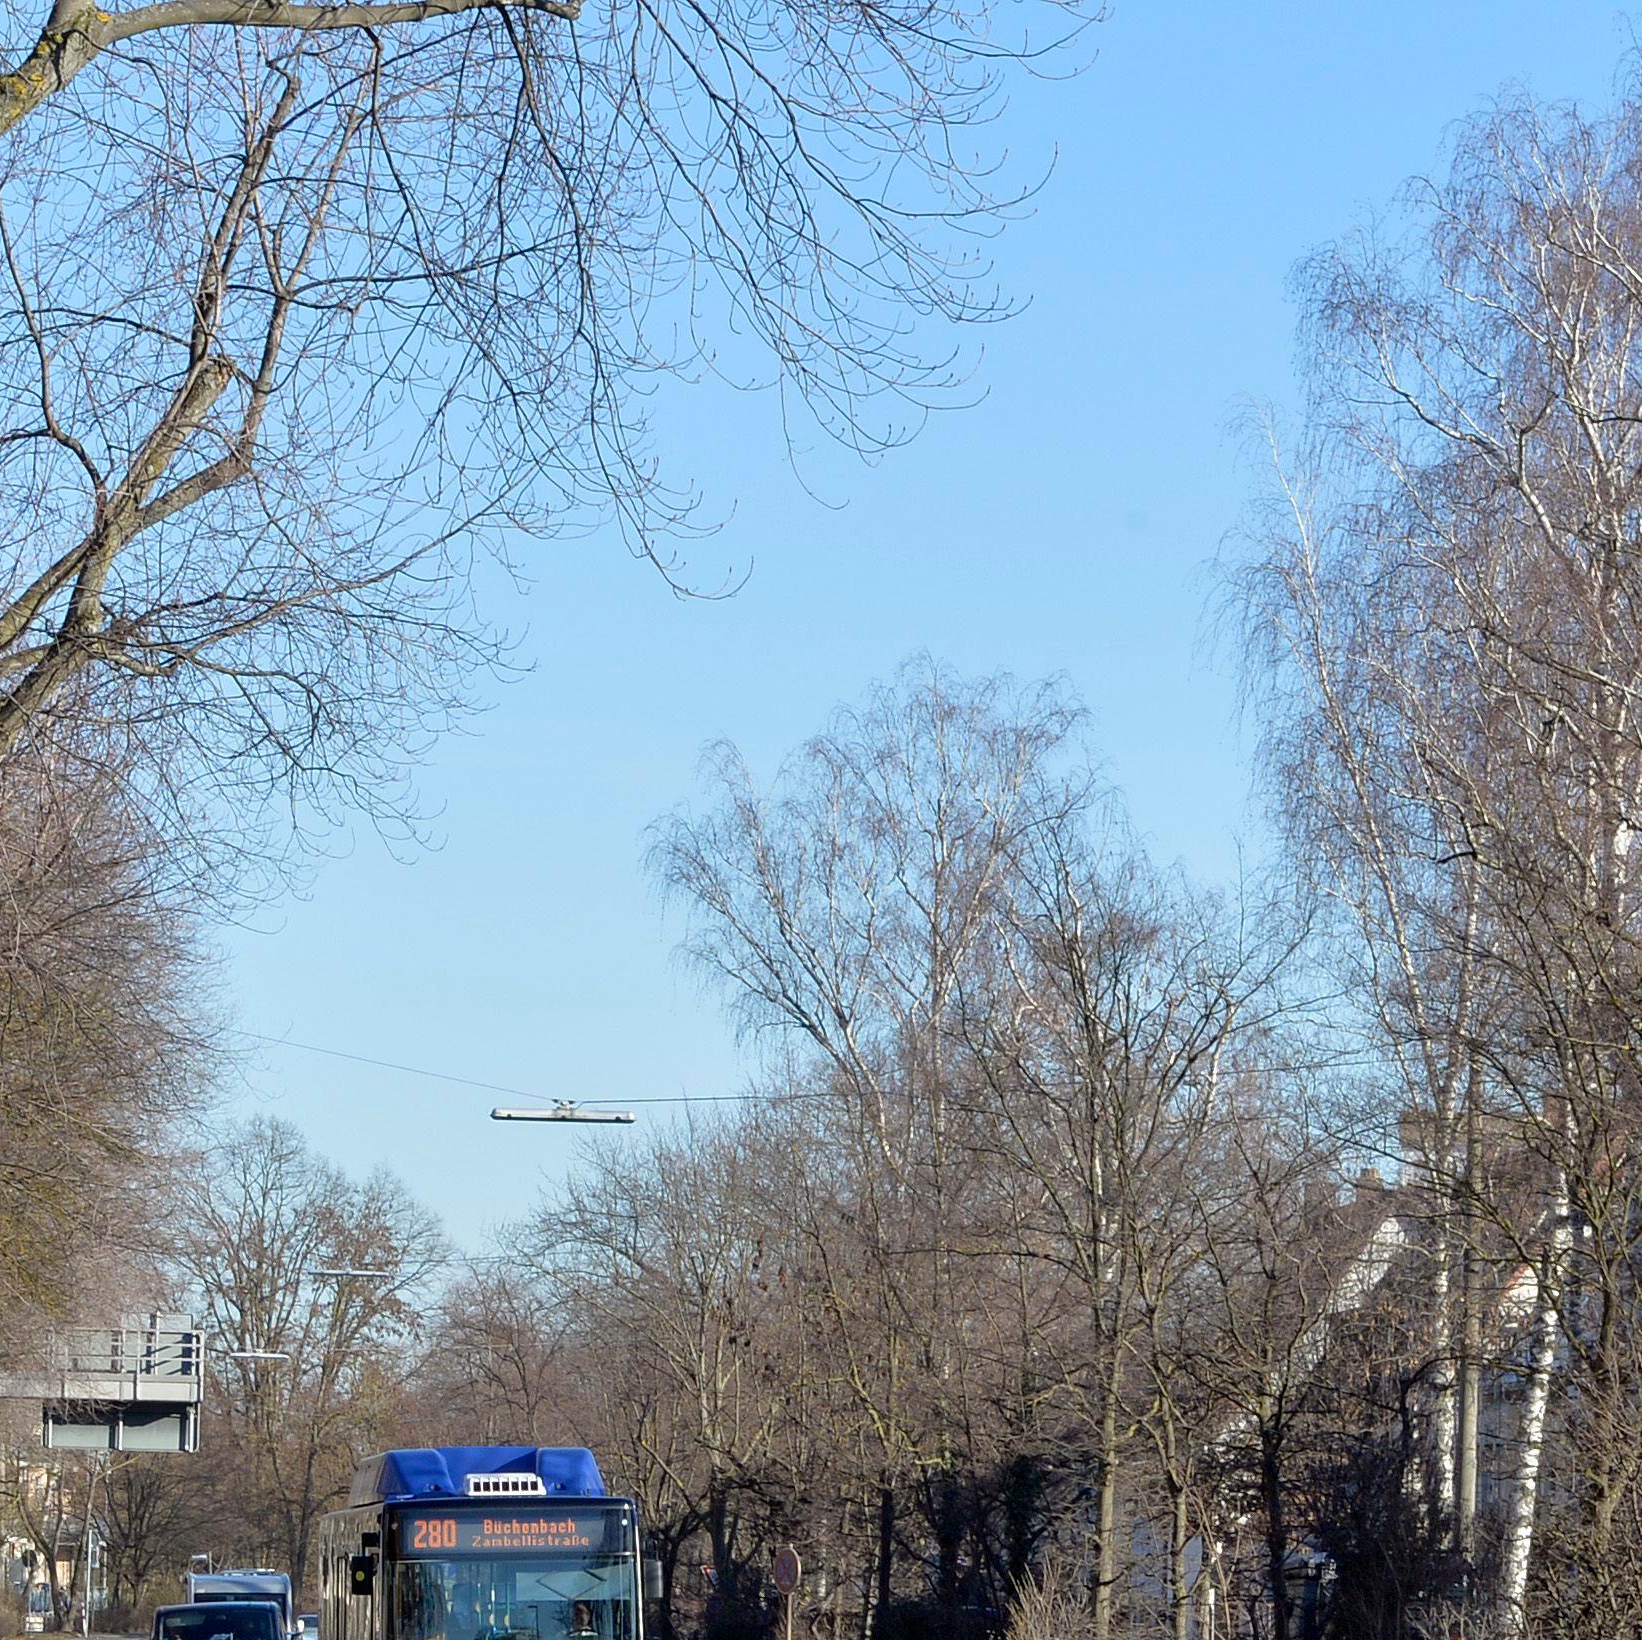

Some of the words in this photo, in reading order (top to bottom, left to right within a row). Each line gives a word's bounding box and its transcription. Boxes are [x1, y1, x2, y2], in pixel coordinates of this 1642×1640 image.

[414, 1519, 456, 1548] 280
[483, 1518, 576, 1534] Büchenbach
[472, 1534, 590, 1548] Zambellistraße
